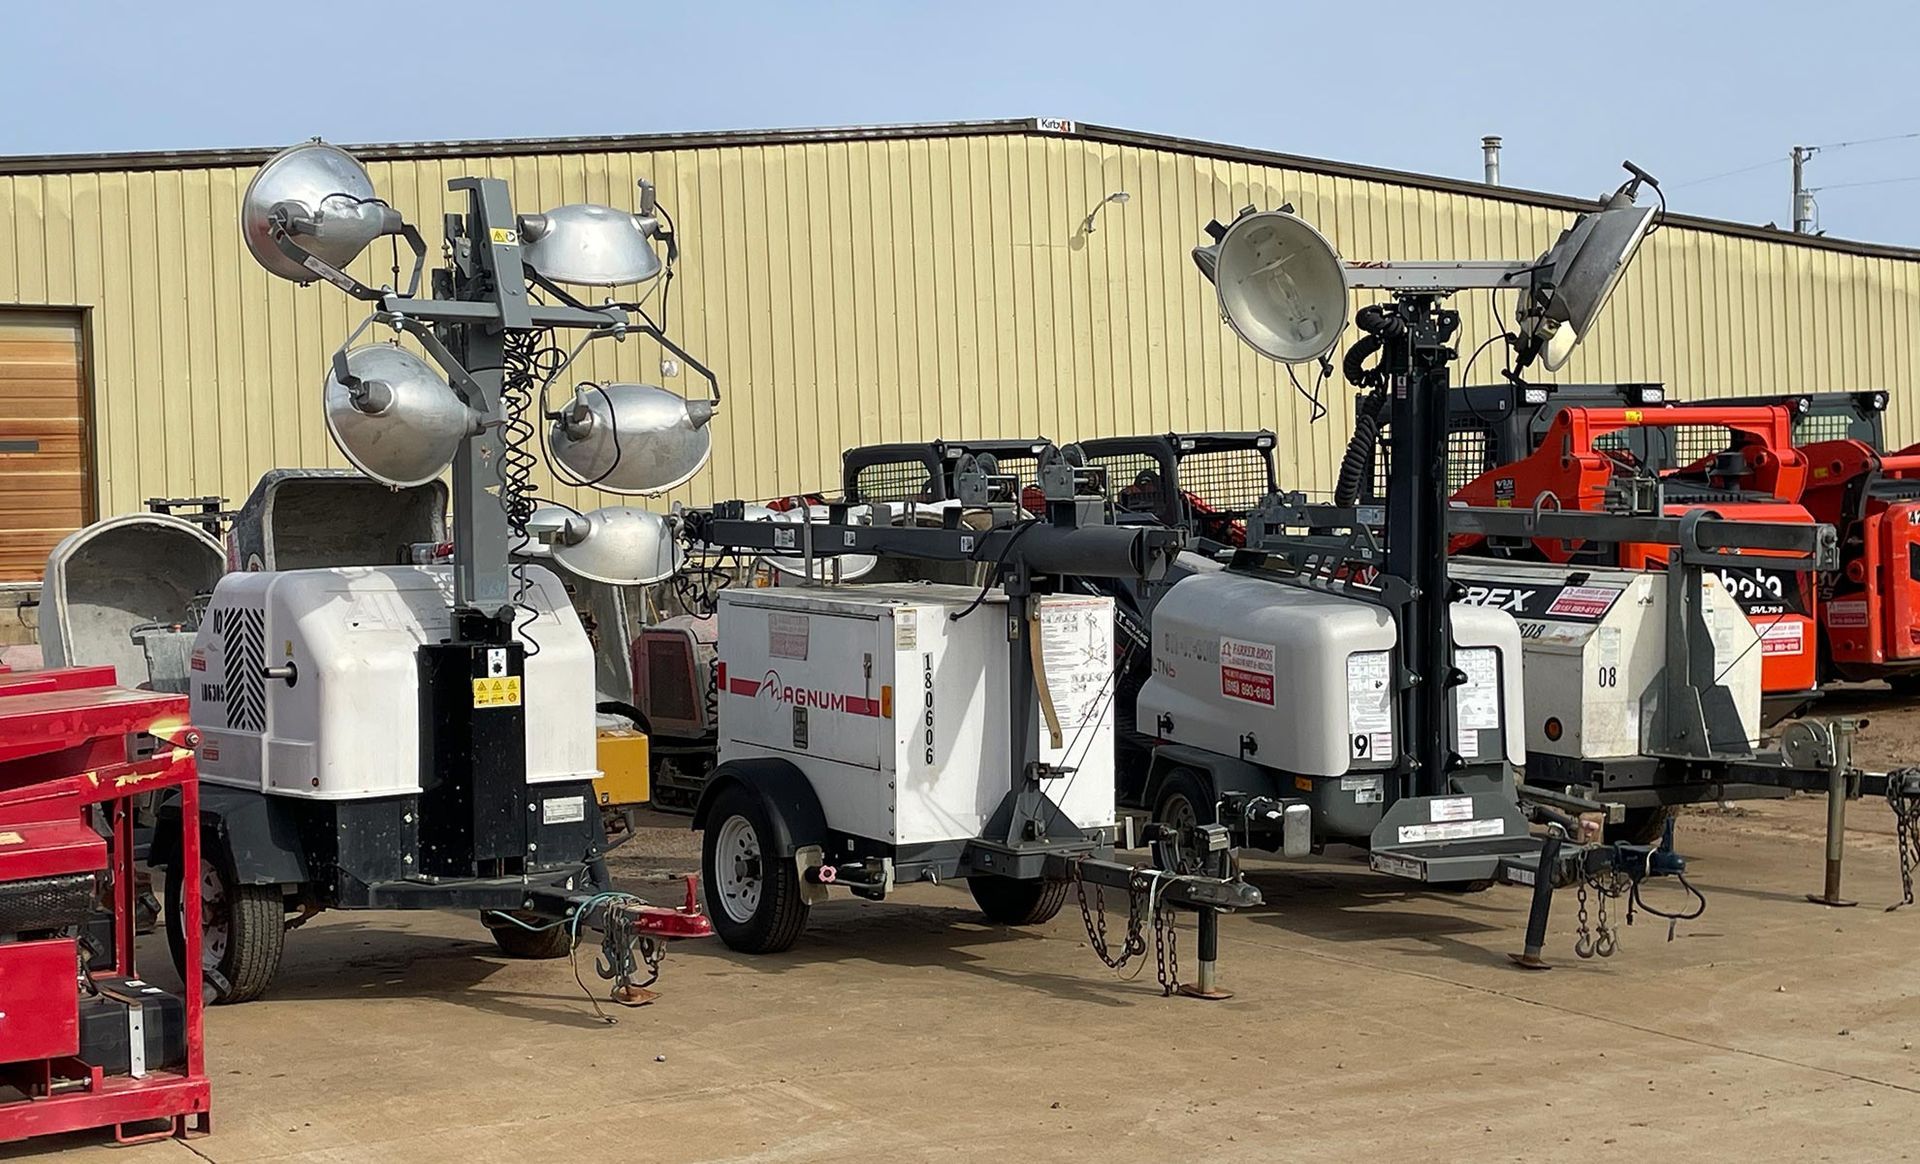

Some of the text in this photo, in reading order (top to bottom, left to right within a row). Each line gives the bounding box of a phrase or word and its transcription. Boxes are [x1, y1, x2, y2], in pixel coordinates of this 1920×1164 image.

[1517, 622, 1546, 639] 608
[1599, 667, 1616, 687] 08
[760, 677, 845, 712] MAGNUM
[925, 654, 934, 764] 180606
[1354, 735, 1368, 756] 9
